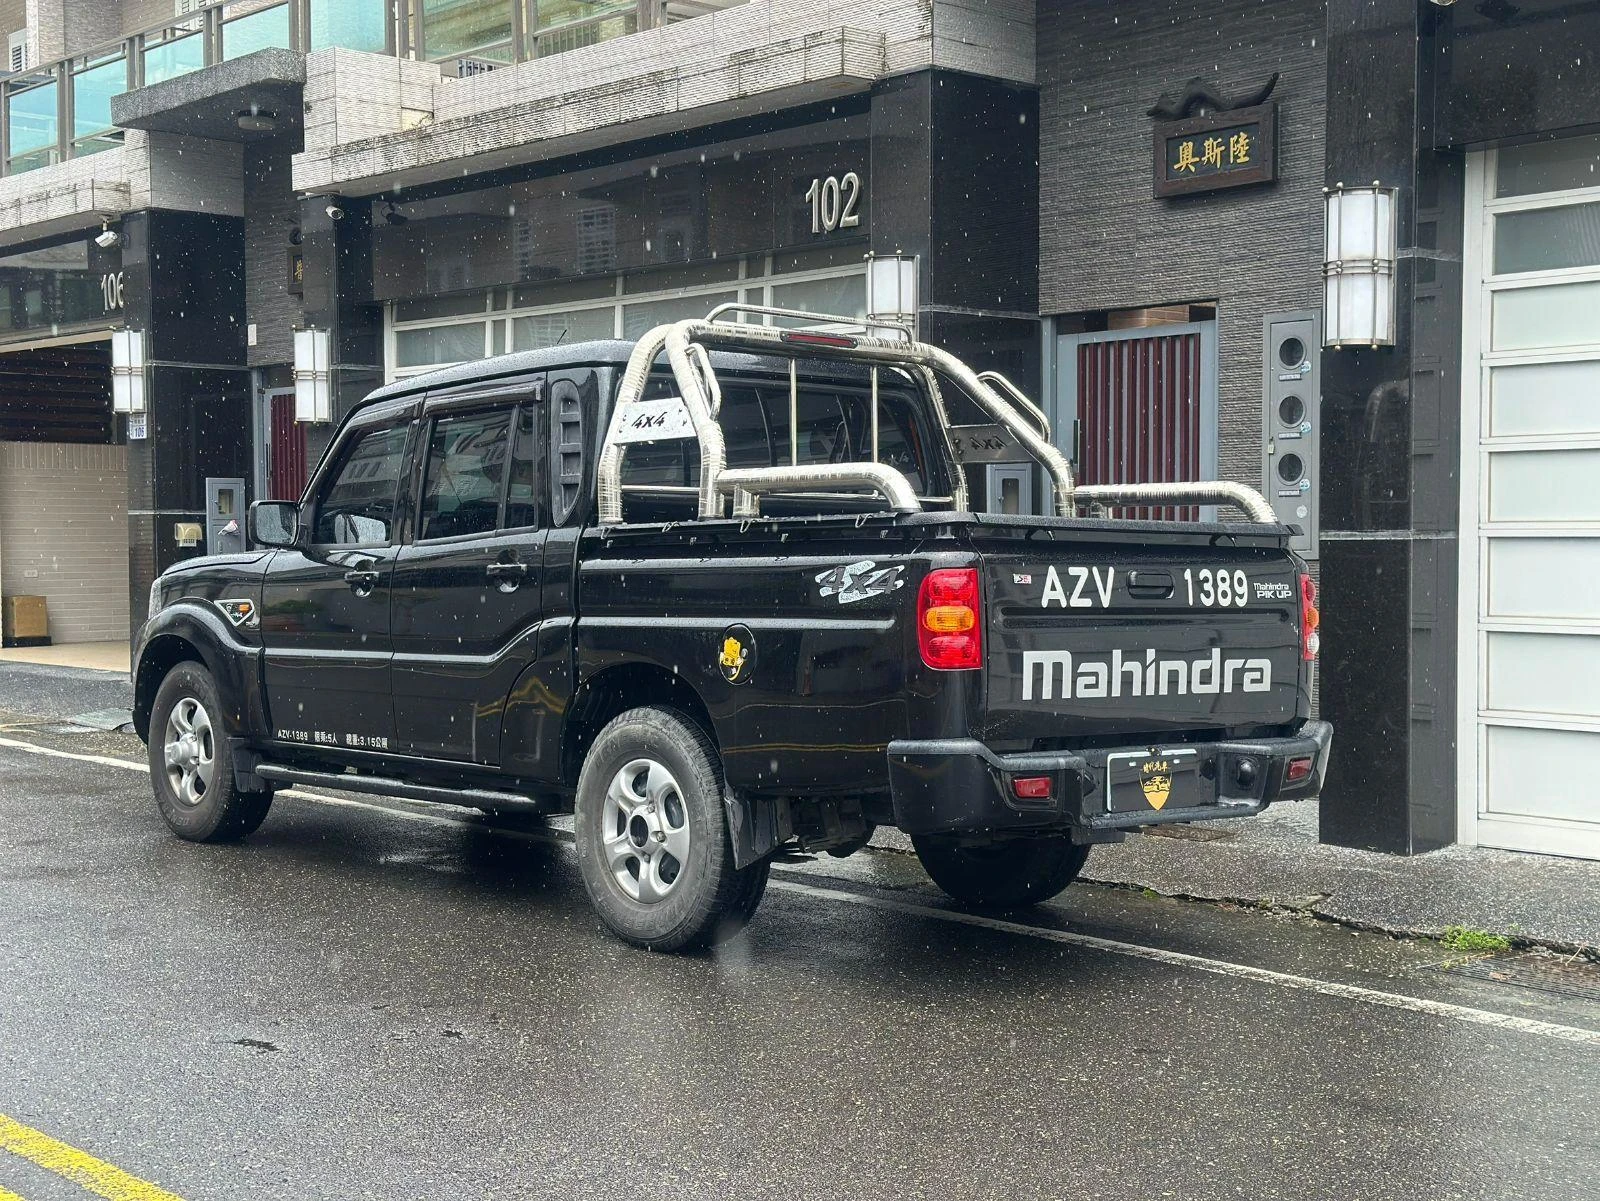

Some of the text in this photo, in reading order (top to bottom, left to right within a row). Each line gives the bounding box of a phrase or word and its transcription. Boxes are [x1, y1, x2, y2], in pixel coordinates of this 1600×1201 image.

[1173, 131, 1250, 173] 奧斯陸
[805, 172, 859, 234] 102
[101, 271, 123, 310] 106
[1041, 565, 1248, 608] AZV 1389
[1253, 582, 1289, 591] Mahindra
[1022, 647, 1272, 701] Mahindra
[277, 729, 308, 741] AZV-1389
